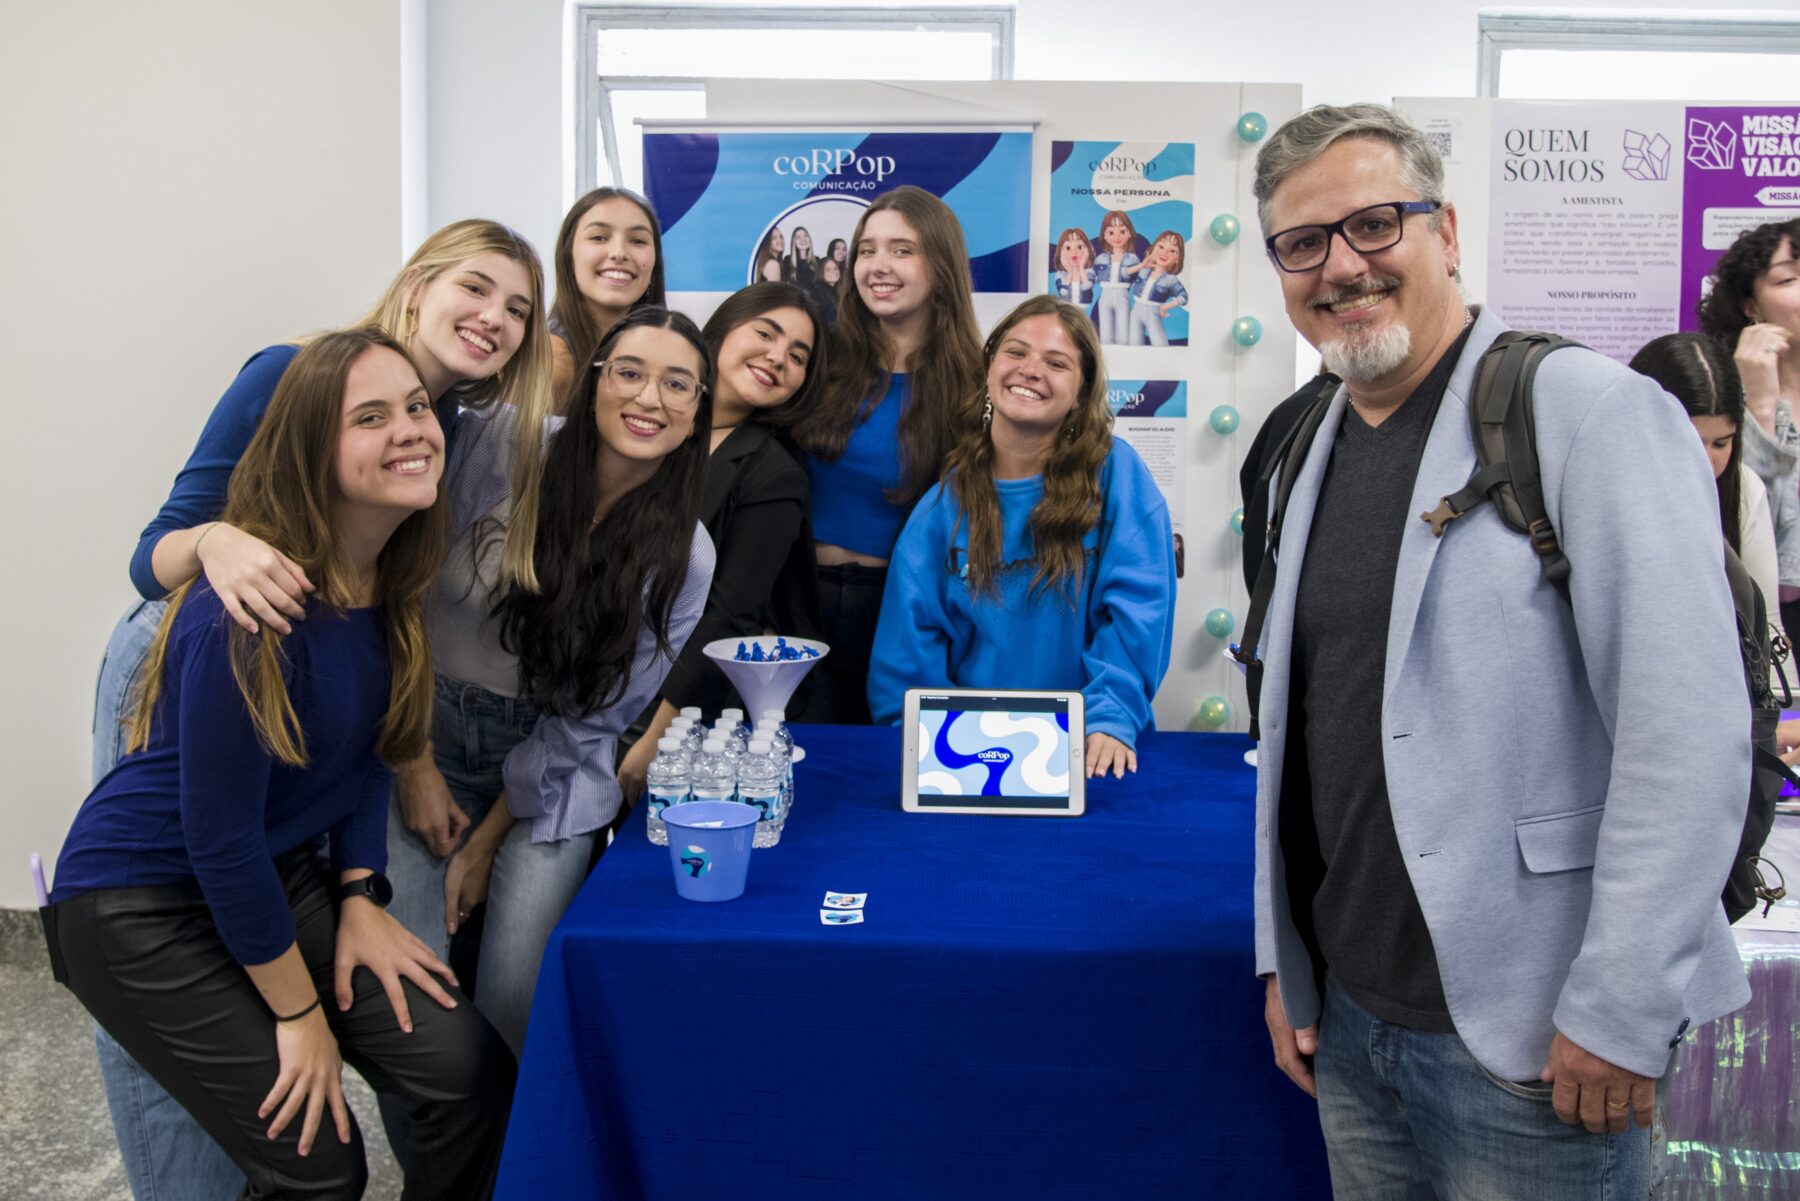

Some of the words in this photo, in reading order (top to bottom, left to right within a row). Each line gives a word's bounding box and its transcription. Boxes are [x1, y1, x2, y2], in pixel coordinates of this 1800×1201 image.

[1504, 129, 1590, 157] QUEM
[773, 148, 896, 182] coRPop
[1089, 157, 1157, 176] coRPop
[1504, 159, 1605, 183] SOMOS
[792, 180, 877, 192] COMUNICAÇÃO
[1071, 188, 1112, 196] NOSSA
[1113, 189, 1171, 197] PERSONA
[1562, 197, 1568, 205] A
[1547, 291, 1580, 299] NOSSO
[1582, 290, 1636, 299] PROPÓSITO
[1106, 390, 1145, 406] RPop
